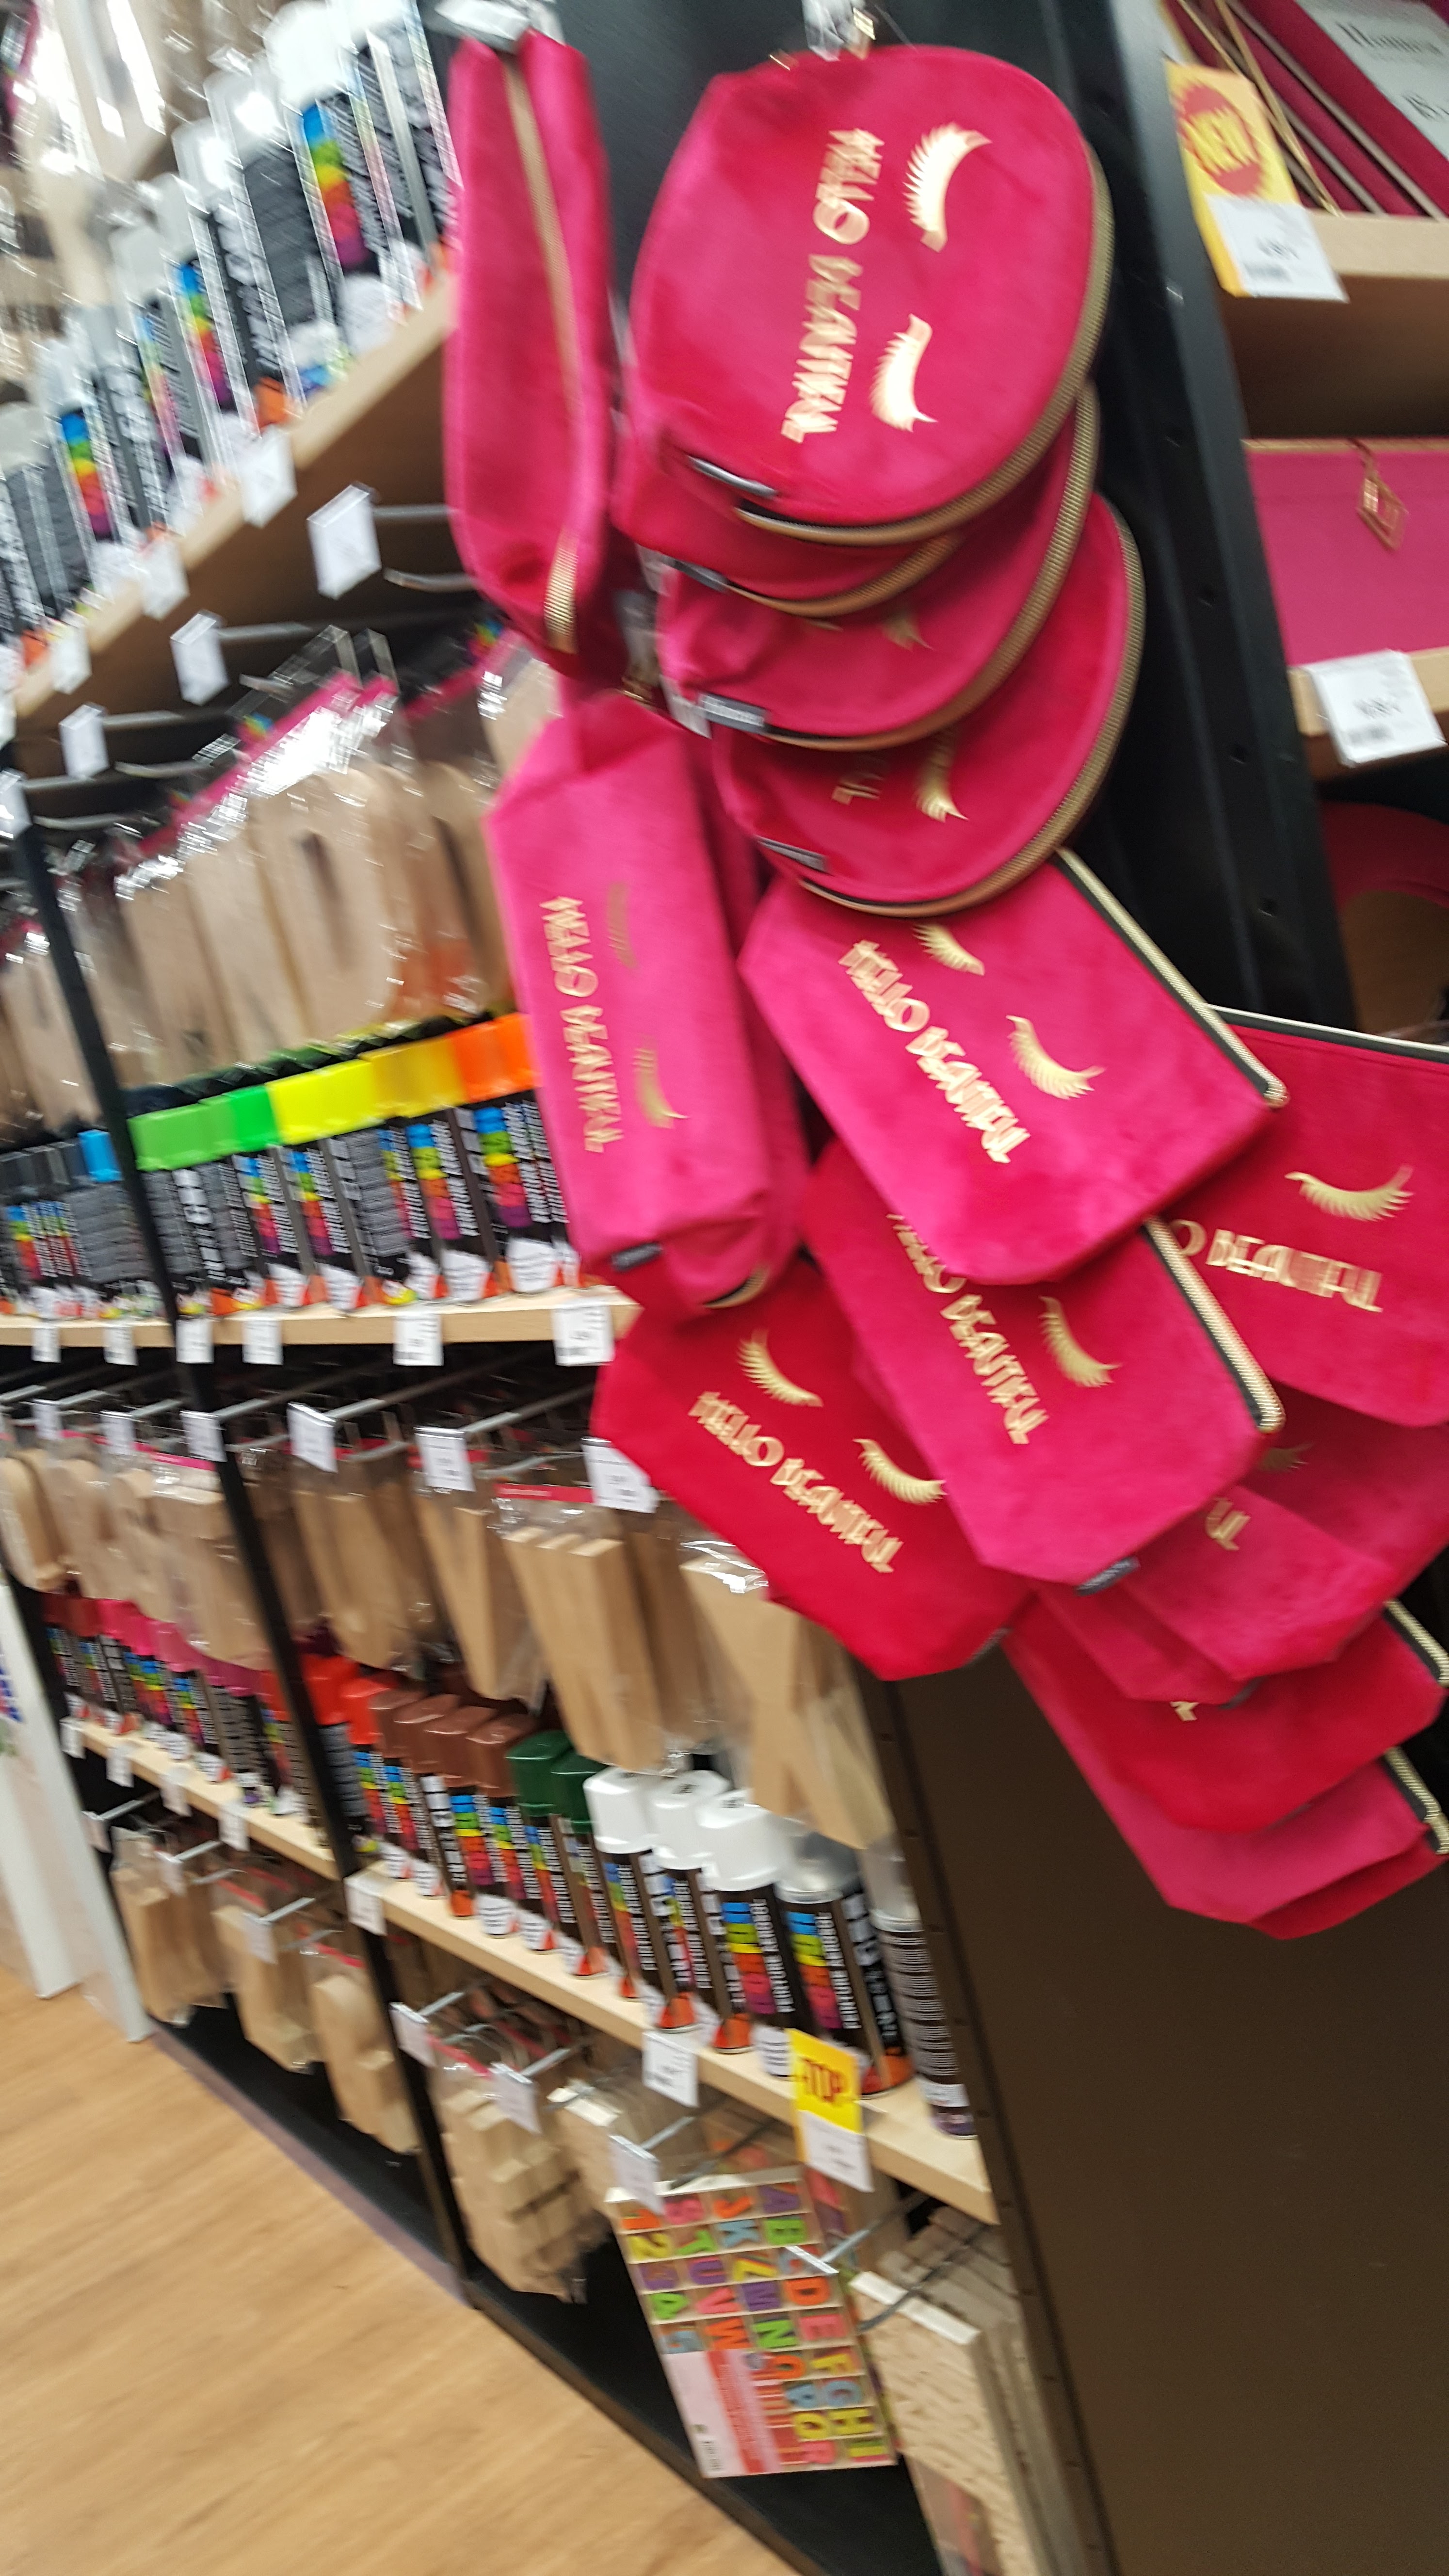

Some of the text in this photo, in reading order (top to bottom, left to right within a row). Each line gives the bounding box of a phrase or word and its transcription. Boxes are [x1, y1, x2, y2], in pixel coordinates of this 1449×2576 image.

[838, 940, 1031, 1164] HELLO BEAUTIFUL
[1206, 1228, 1384, 1313] BEAUTIFUL
[939, 1294, 1050, 1445] BEAUTIFUL
[688, 1391, 904, 1574] HELLO BEAUTIFUL
